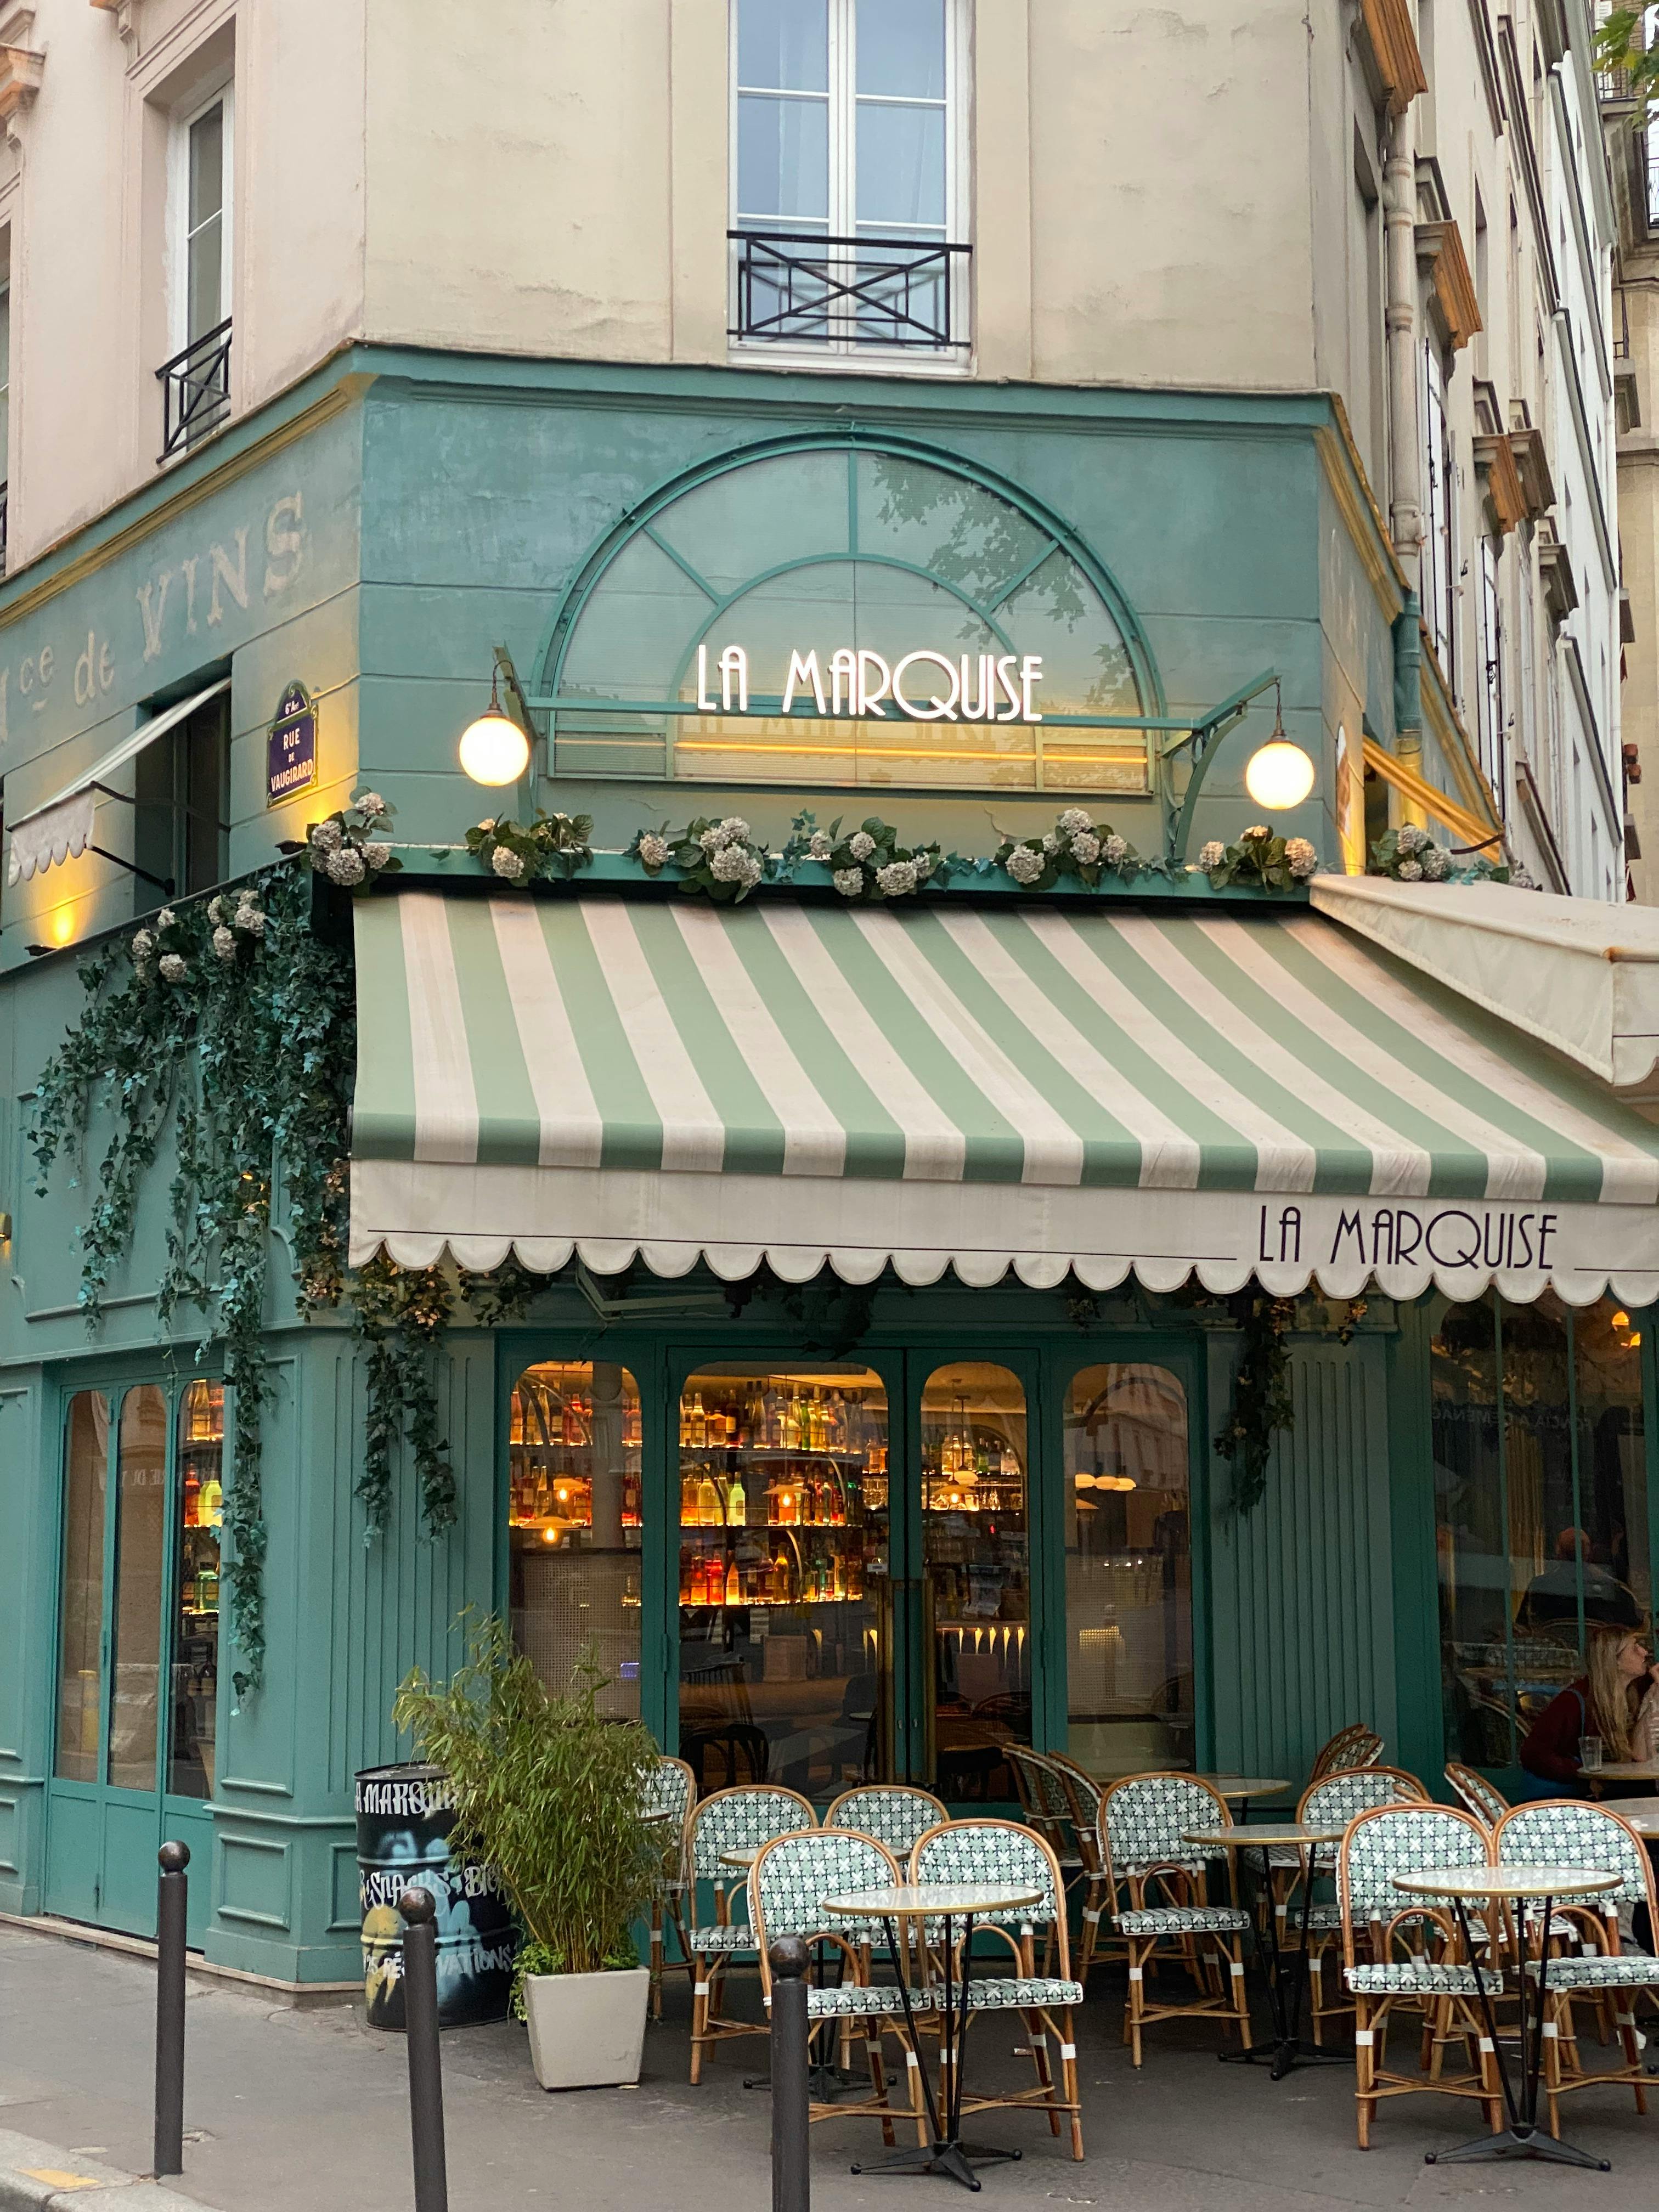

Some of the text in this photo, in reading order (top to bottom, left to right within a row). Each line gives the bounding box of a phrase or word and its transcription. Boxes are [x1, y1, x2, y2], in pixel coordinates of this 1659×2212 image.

[74, 629, 114, 707] de
[136, 490, 303, 663] VINS
[697, 644, 1043, 722] LA MARQUISE
[283, 727, 300, 751] RUE
[288, 752, 295, 763] DE
[270, 759, 313, 792] VAUGIRARD
[1260, 1205, 1558, 1270] LA MARQUISE
